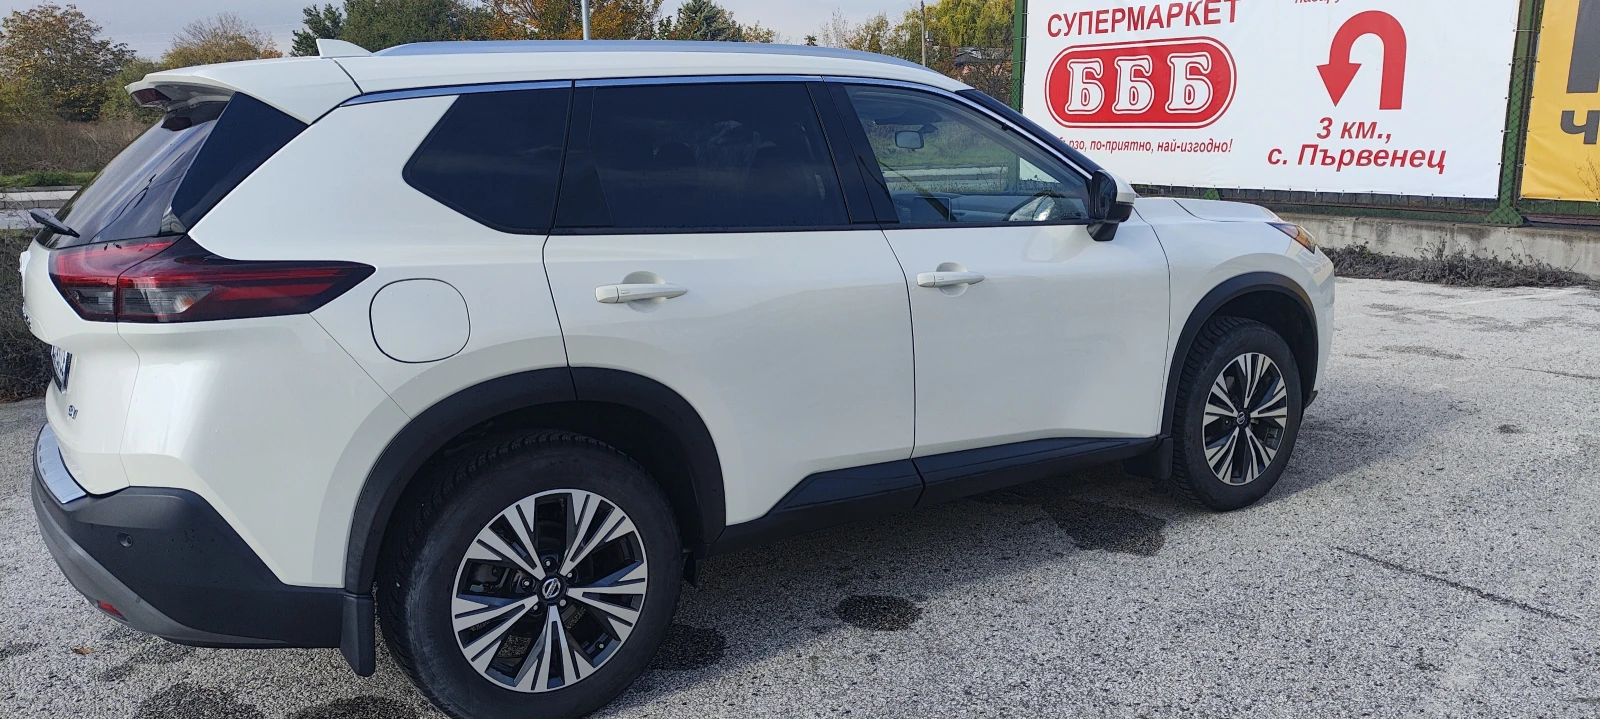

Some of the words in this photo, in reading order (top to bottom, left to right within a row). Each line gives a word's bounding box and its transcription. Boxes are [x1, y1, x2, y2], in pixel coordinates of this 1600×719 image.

[1047, 0, 1241, 37] СУПЕРМАРКЕТ
[1316, 116, 1334, 140] 3
[1340, 121, 1392, 143] км.,
[1089, 139, 1154, 154] по-приятно,
[1157, 138, 1233, 153] най-изгодно!
[1267, 147, 1289, 166] с.
[1297, 144, 1447, 174] Първенец
